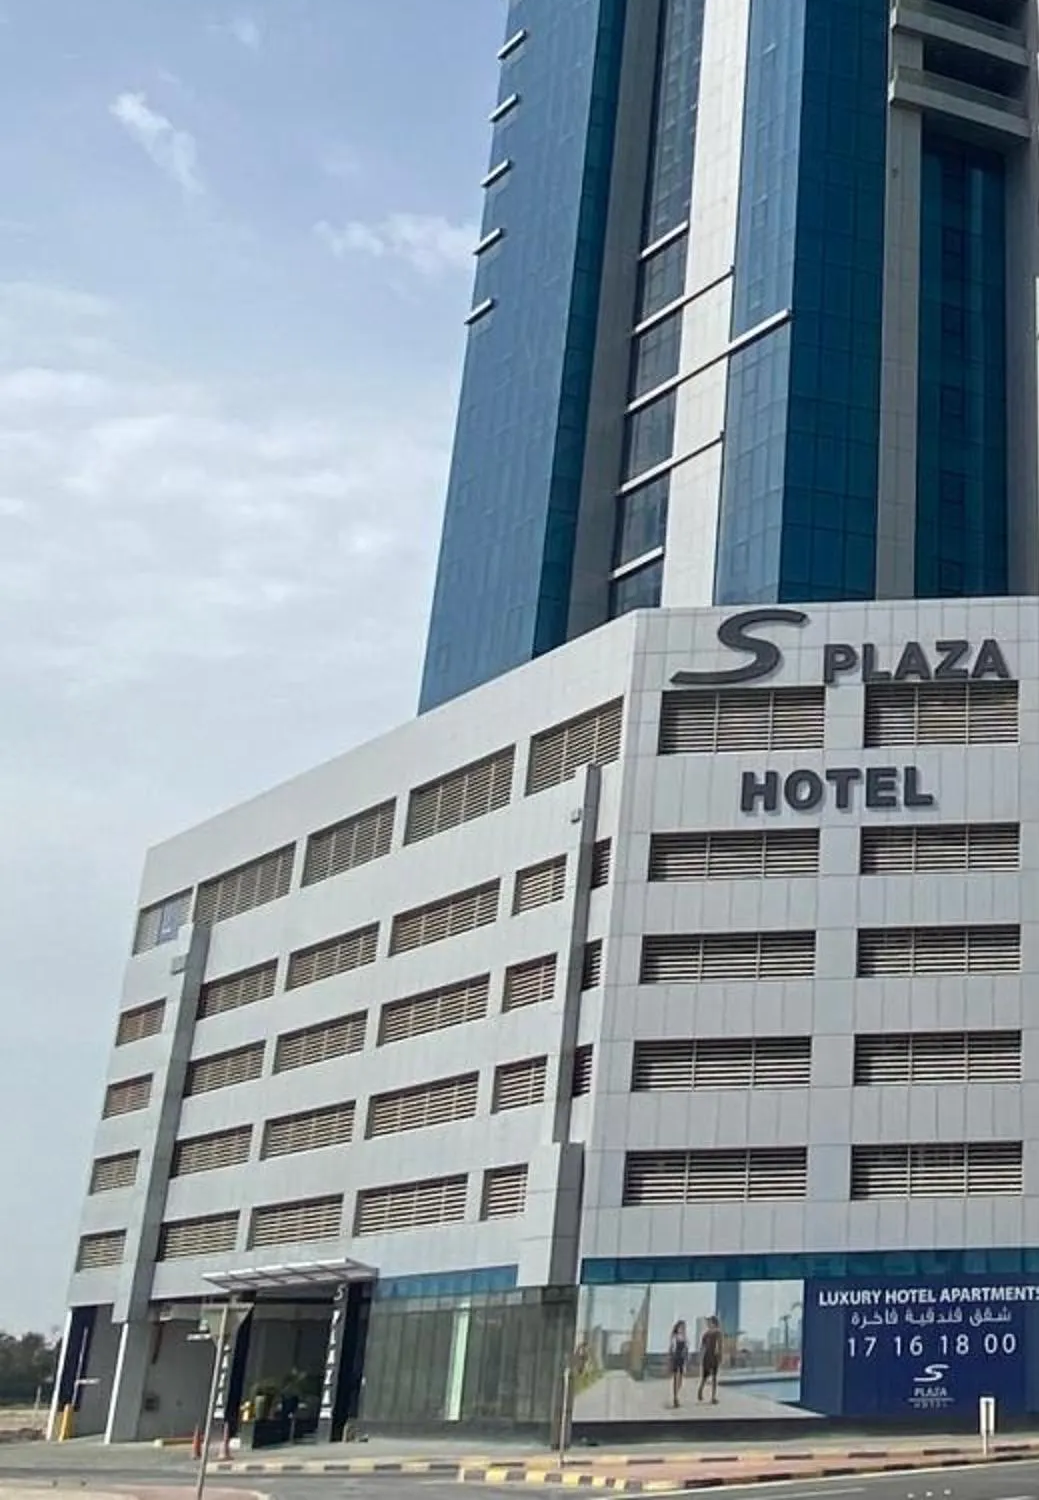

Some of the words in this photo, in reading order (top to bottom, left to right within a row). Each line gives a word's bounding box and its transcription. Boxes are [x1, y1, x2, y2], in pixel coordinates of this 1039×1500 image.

[670, 608, 808, 685] S
[823, 639, 1010, 684] PLAZA
[740, 766, 934, 812] HOTEL
[819, 1290, 881, 1306] LUXURY
[885, 1288, 936, 1304] HOTEL
[851, 1308, 898, 1329] فاخرة
[969, 1305, 1012, 1327] شقق
[848, 1336, 877, 1357] 17
[894, 1335, 923, 1357] 16
[940, 1334, 969, 1355] 18
[984, 1333, 1016, 1354] 00
